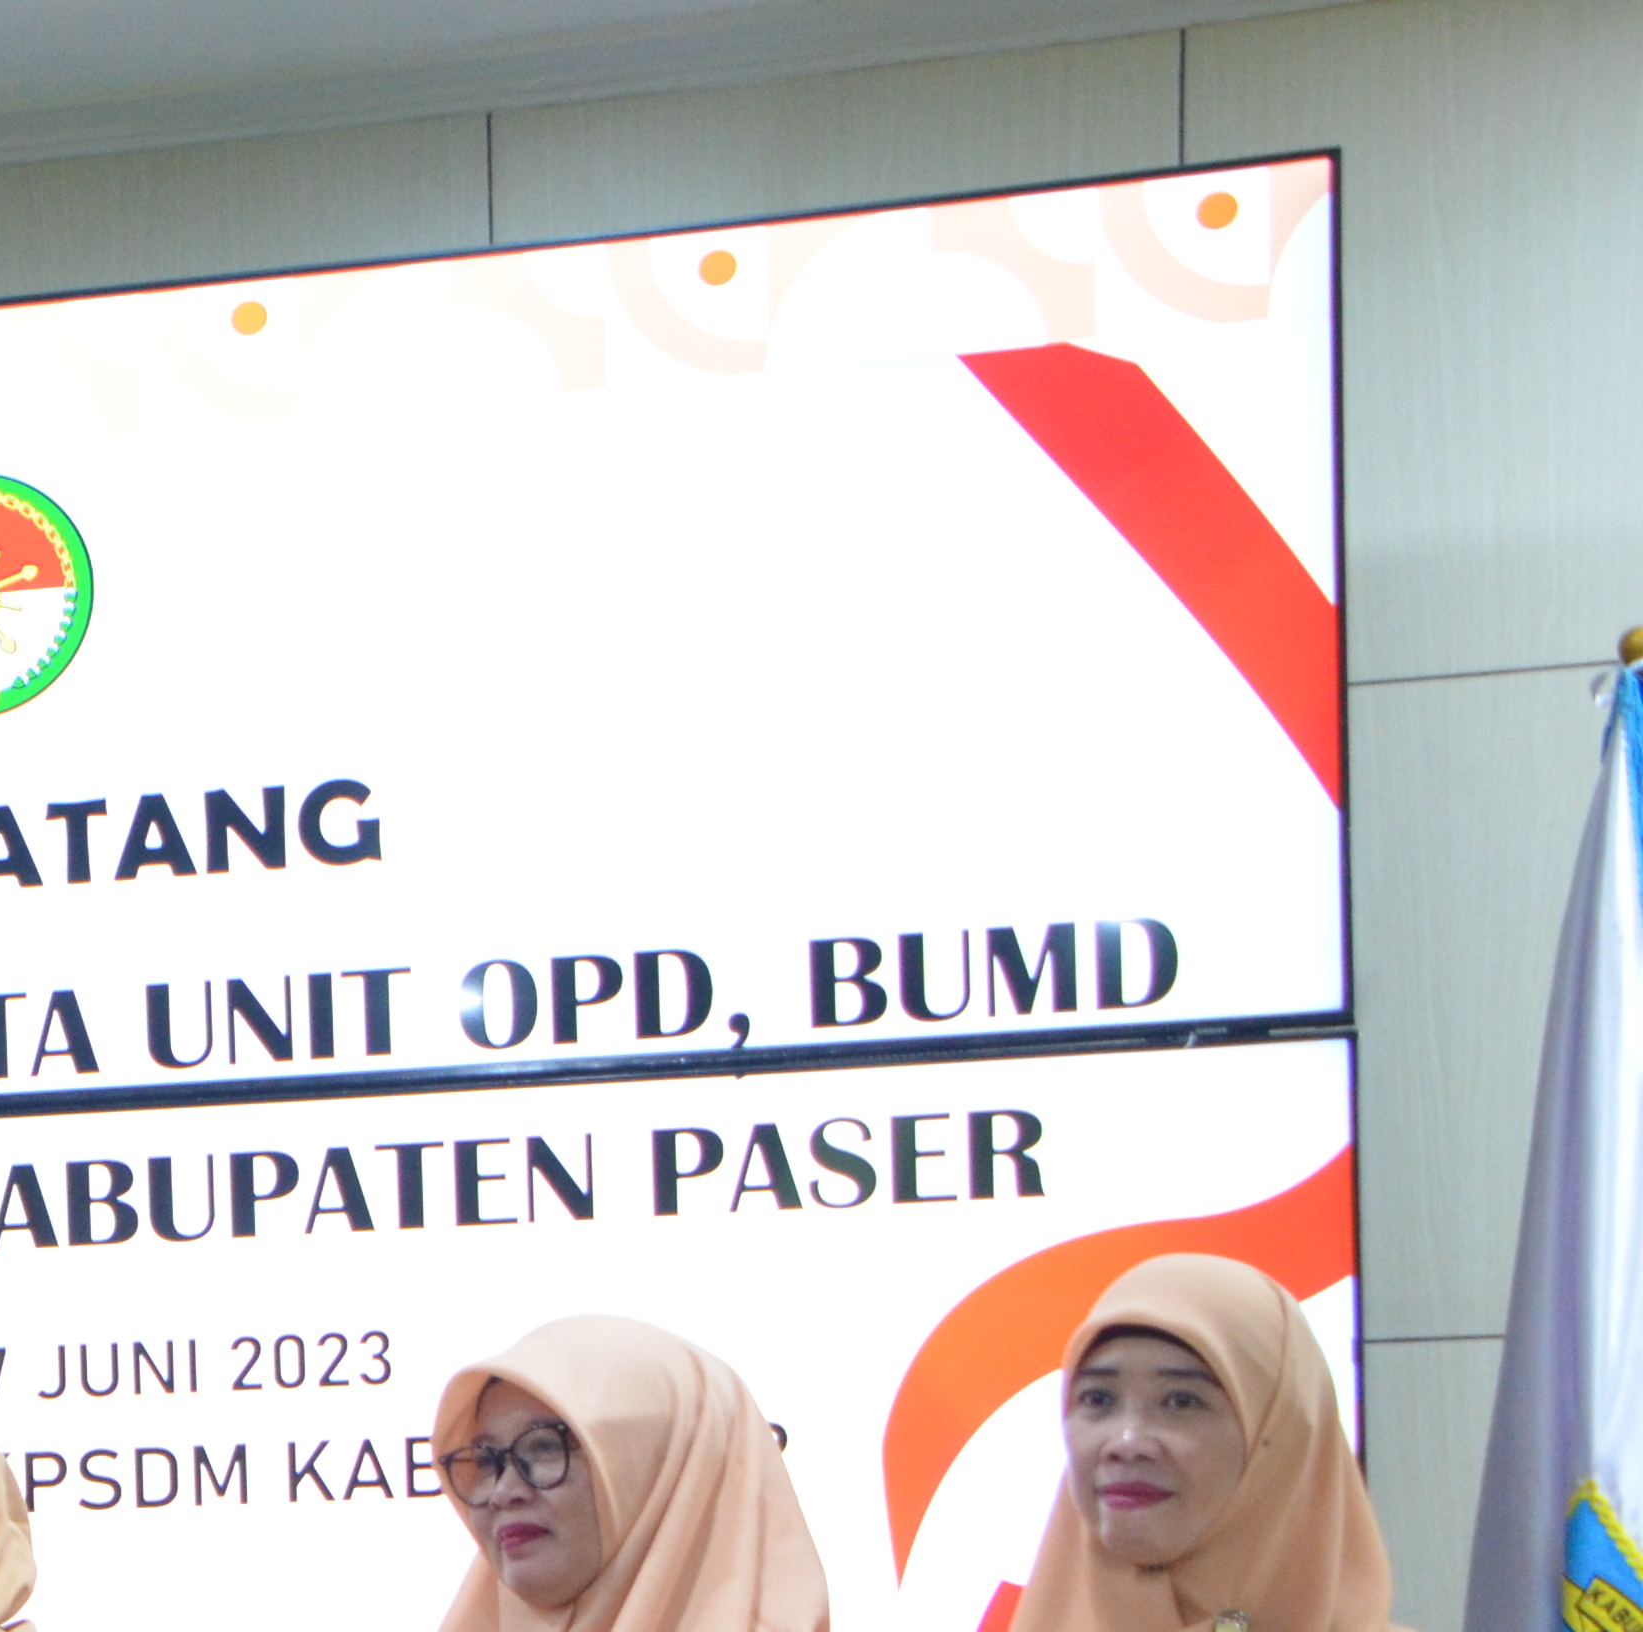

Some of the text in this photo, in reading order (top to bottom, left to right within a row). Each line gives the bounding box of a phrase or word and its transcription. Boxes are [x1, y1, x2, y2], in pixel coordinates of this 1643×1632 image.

[146, 966, 411, 1069] UNIT
[459, 949, 751, 1056] OPD,
[810, 917, 1179, 1029] BUMD
[653, 1109, 1045, 1216] PASER
[38, 1339, 198, 1399] JUNI
[230, 1330, 392, 1391] 2023
